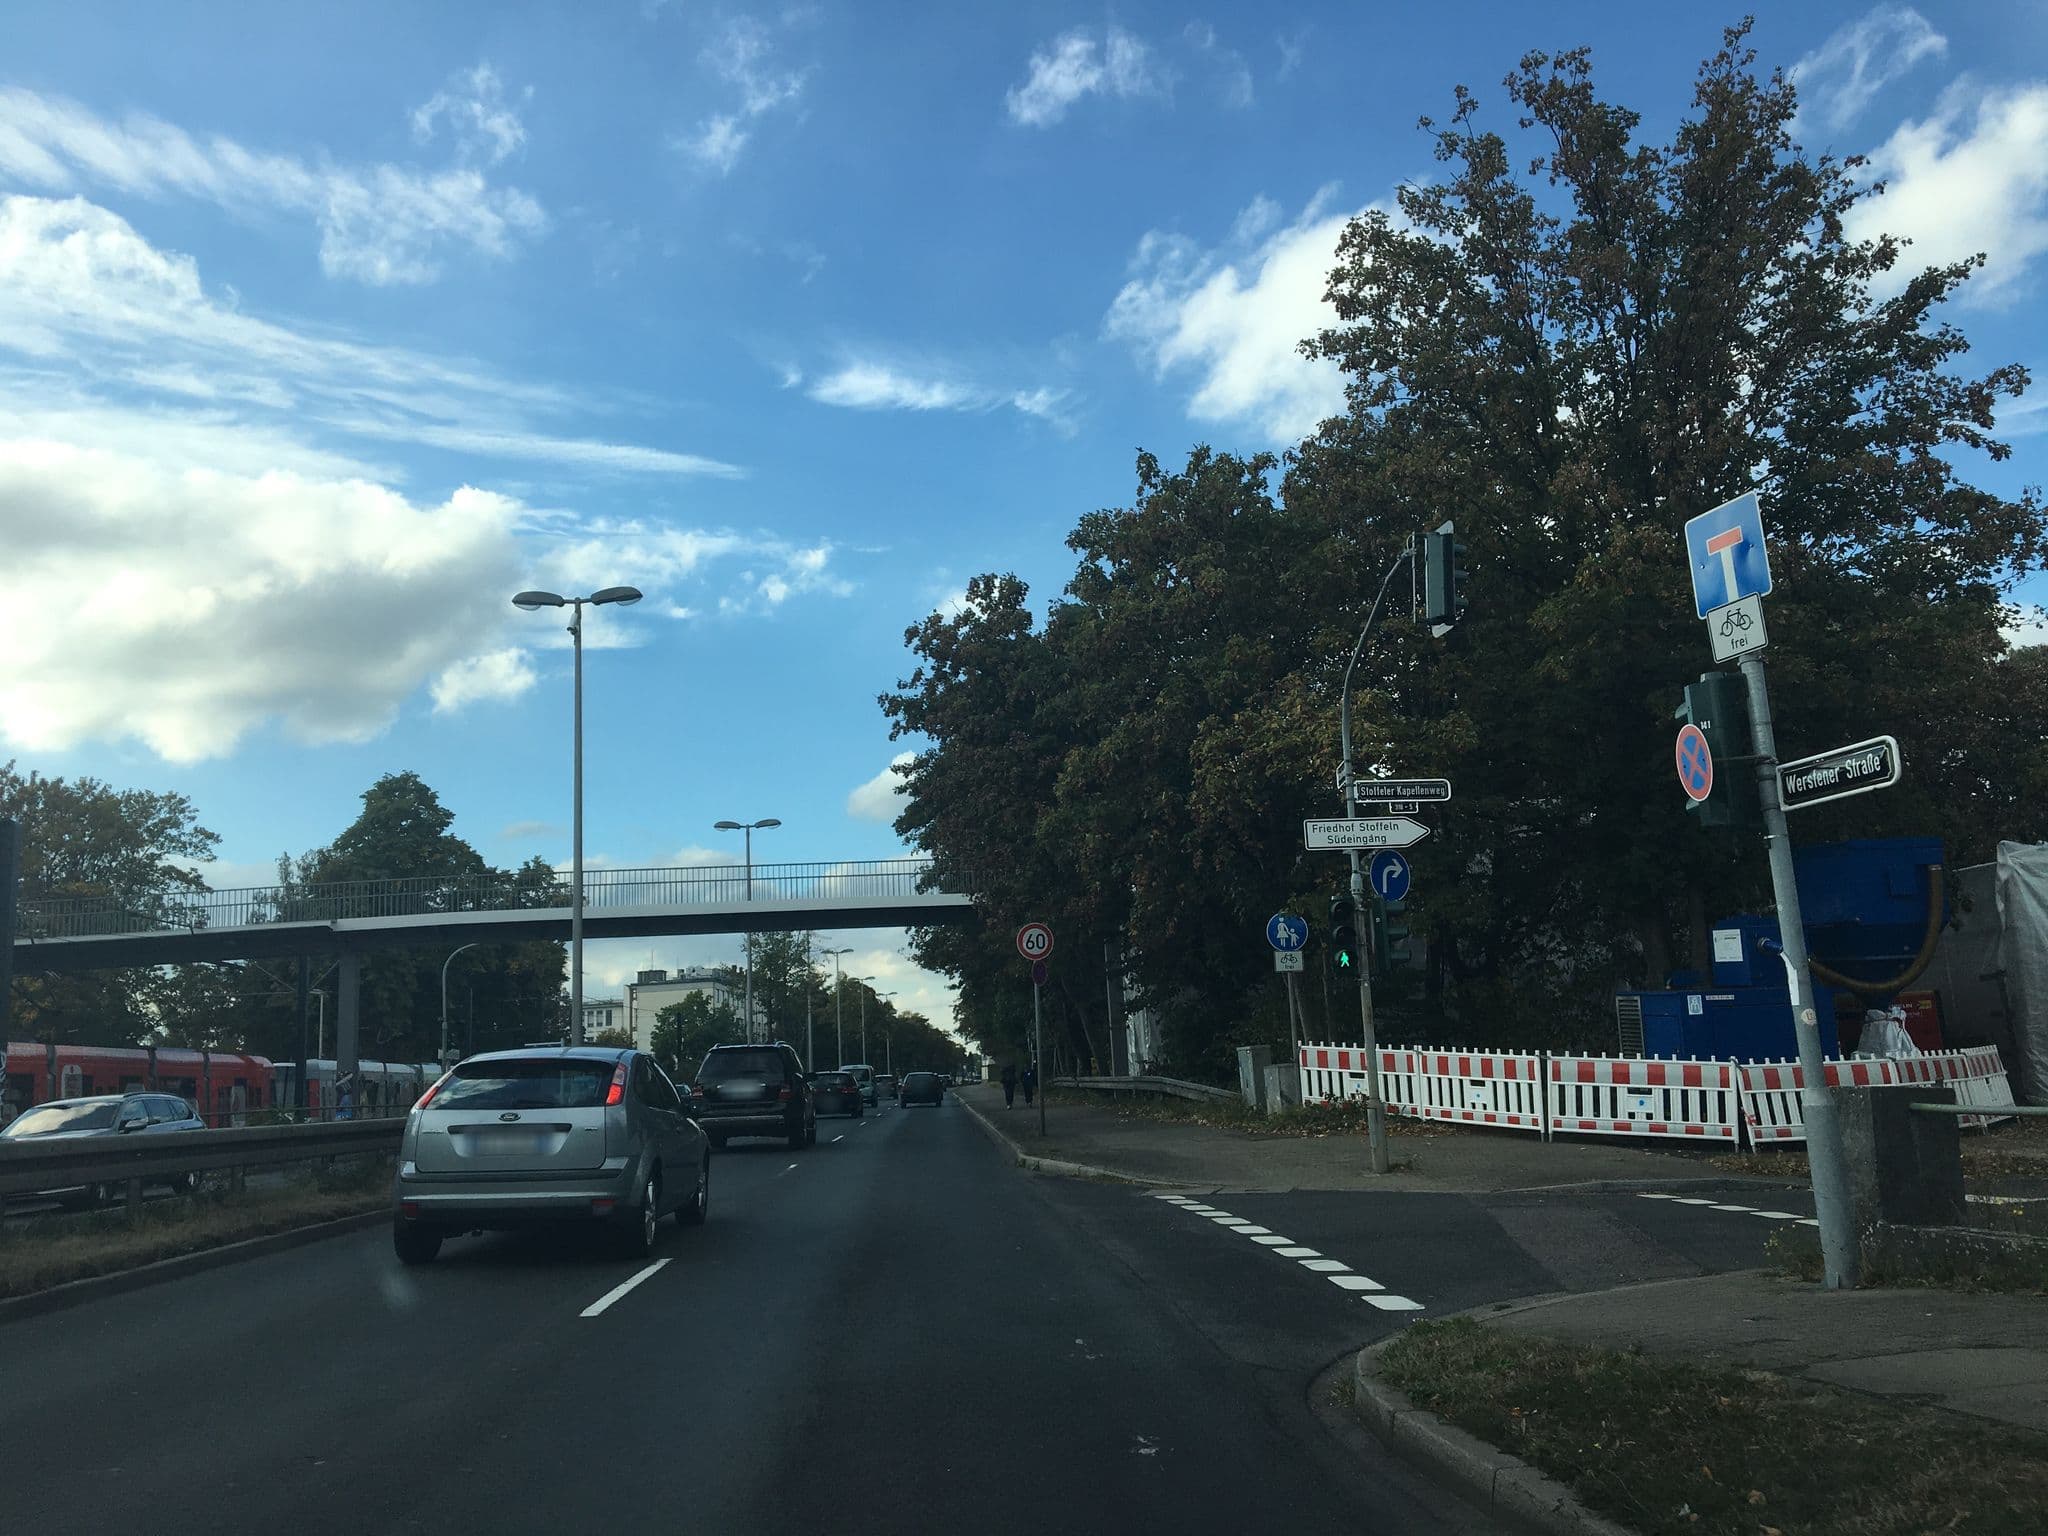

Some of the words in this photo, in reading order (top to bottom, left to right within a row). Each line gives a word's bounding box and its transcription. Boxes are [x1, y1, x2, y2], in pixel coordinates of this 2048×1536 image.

[1731, 635, 1748, 650] frei
[1786, 766, 1840, 794] Werstener
[1845, 754, 1881, 779] Straße
[1360, 786, 1395, 796] Stoffeler
[1397, 786, 1446, 796] Kapellenweg
[1312, 823, 1355, 833] Friedhof
[1359, 822, 1399, 832] Stoffeln
[1026, 934, 1046, 950] 60
